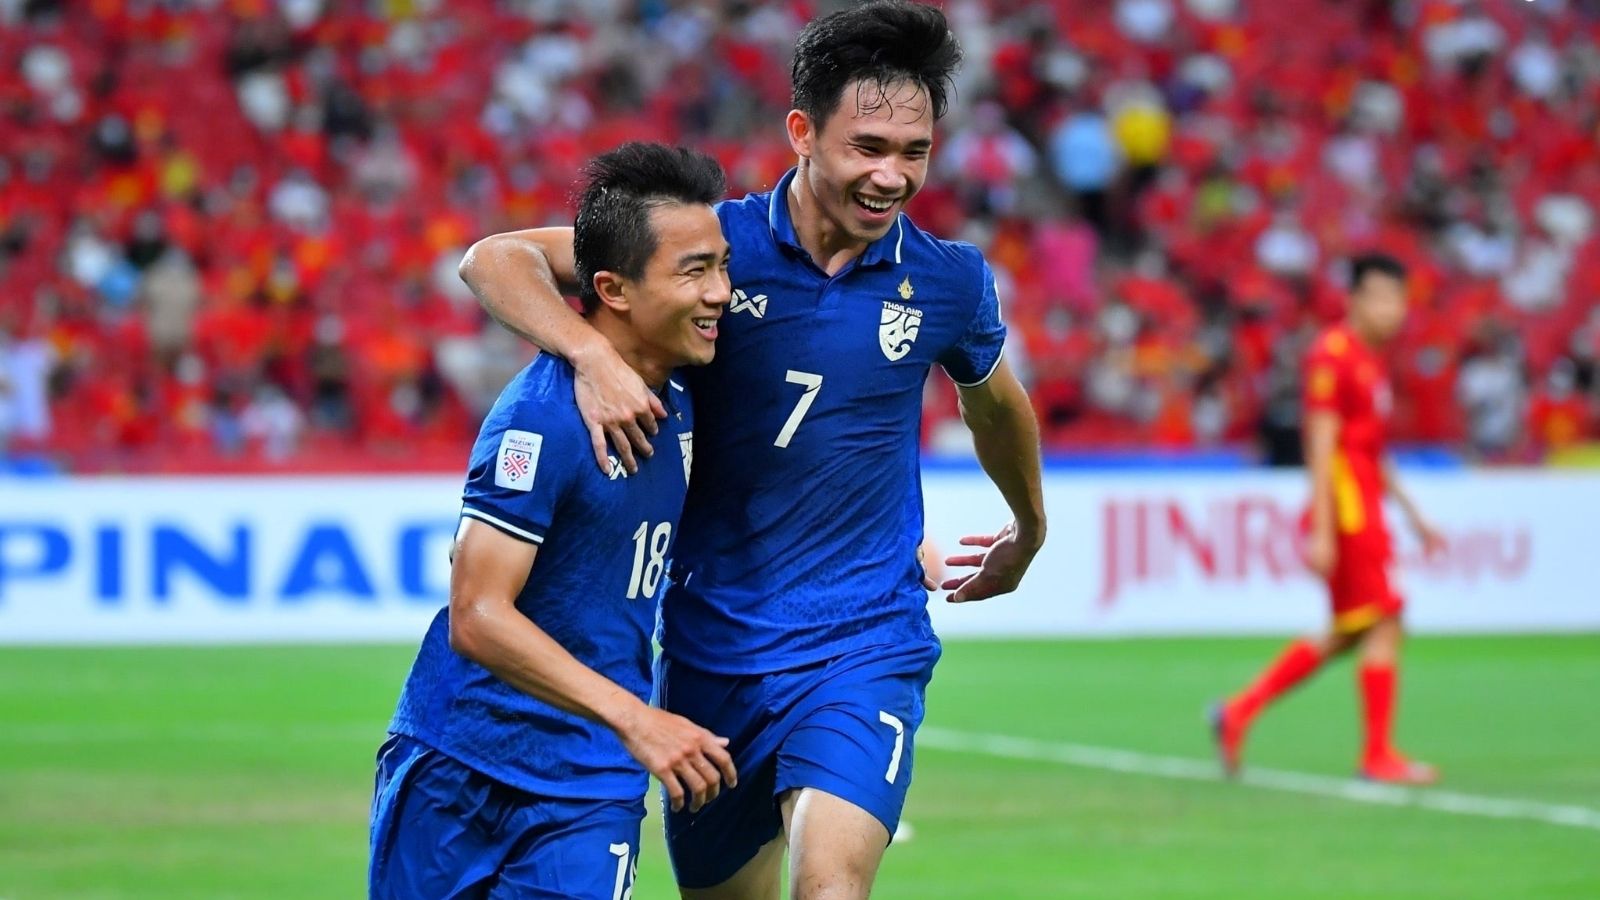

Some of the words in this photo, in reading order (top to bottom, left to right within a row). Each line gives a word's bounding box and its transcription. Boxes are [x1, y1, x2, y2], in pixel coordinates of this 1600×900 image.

[882, 301, 923, 318] THAILAND
[774, 369, 823, 448] 7
[626, 521, 672, 599] 18
[879, 710, 904, 784] 7
